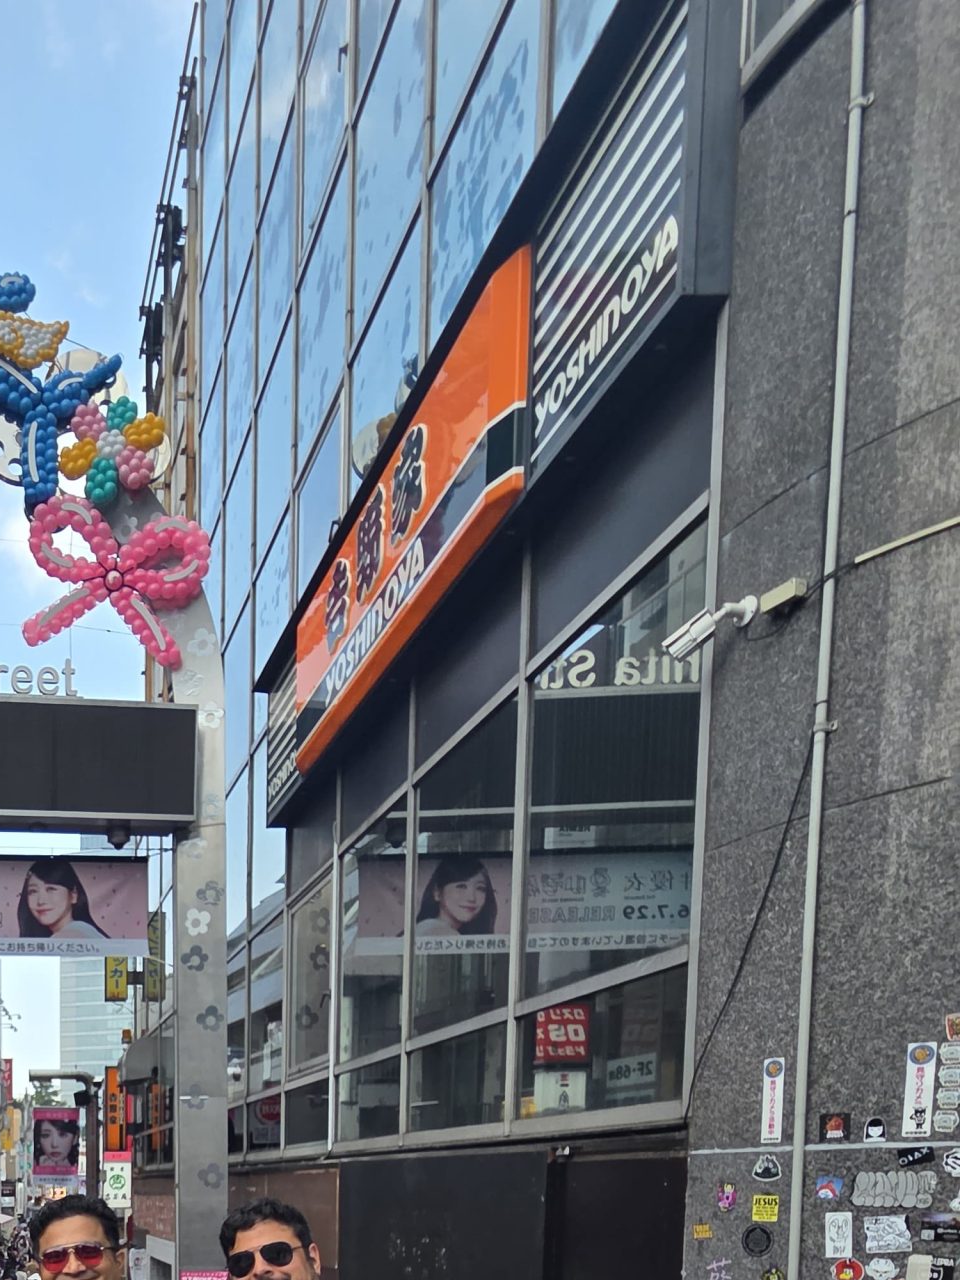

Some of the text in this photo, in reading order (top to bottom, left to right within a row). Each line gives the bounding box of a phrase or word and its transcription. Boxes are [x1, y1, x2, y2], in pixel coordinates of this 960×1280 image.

[535, 214, 679, 439] YOSHINOYA
[324, 536, 425, 707] YOSHINOYA
[325, 422, 428, 655] 吉野家
[753, 1197, 779, 1206] JESUS
